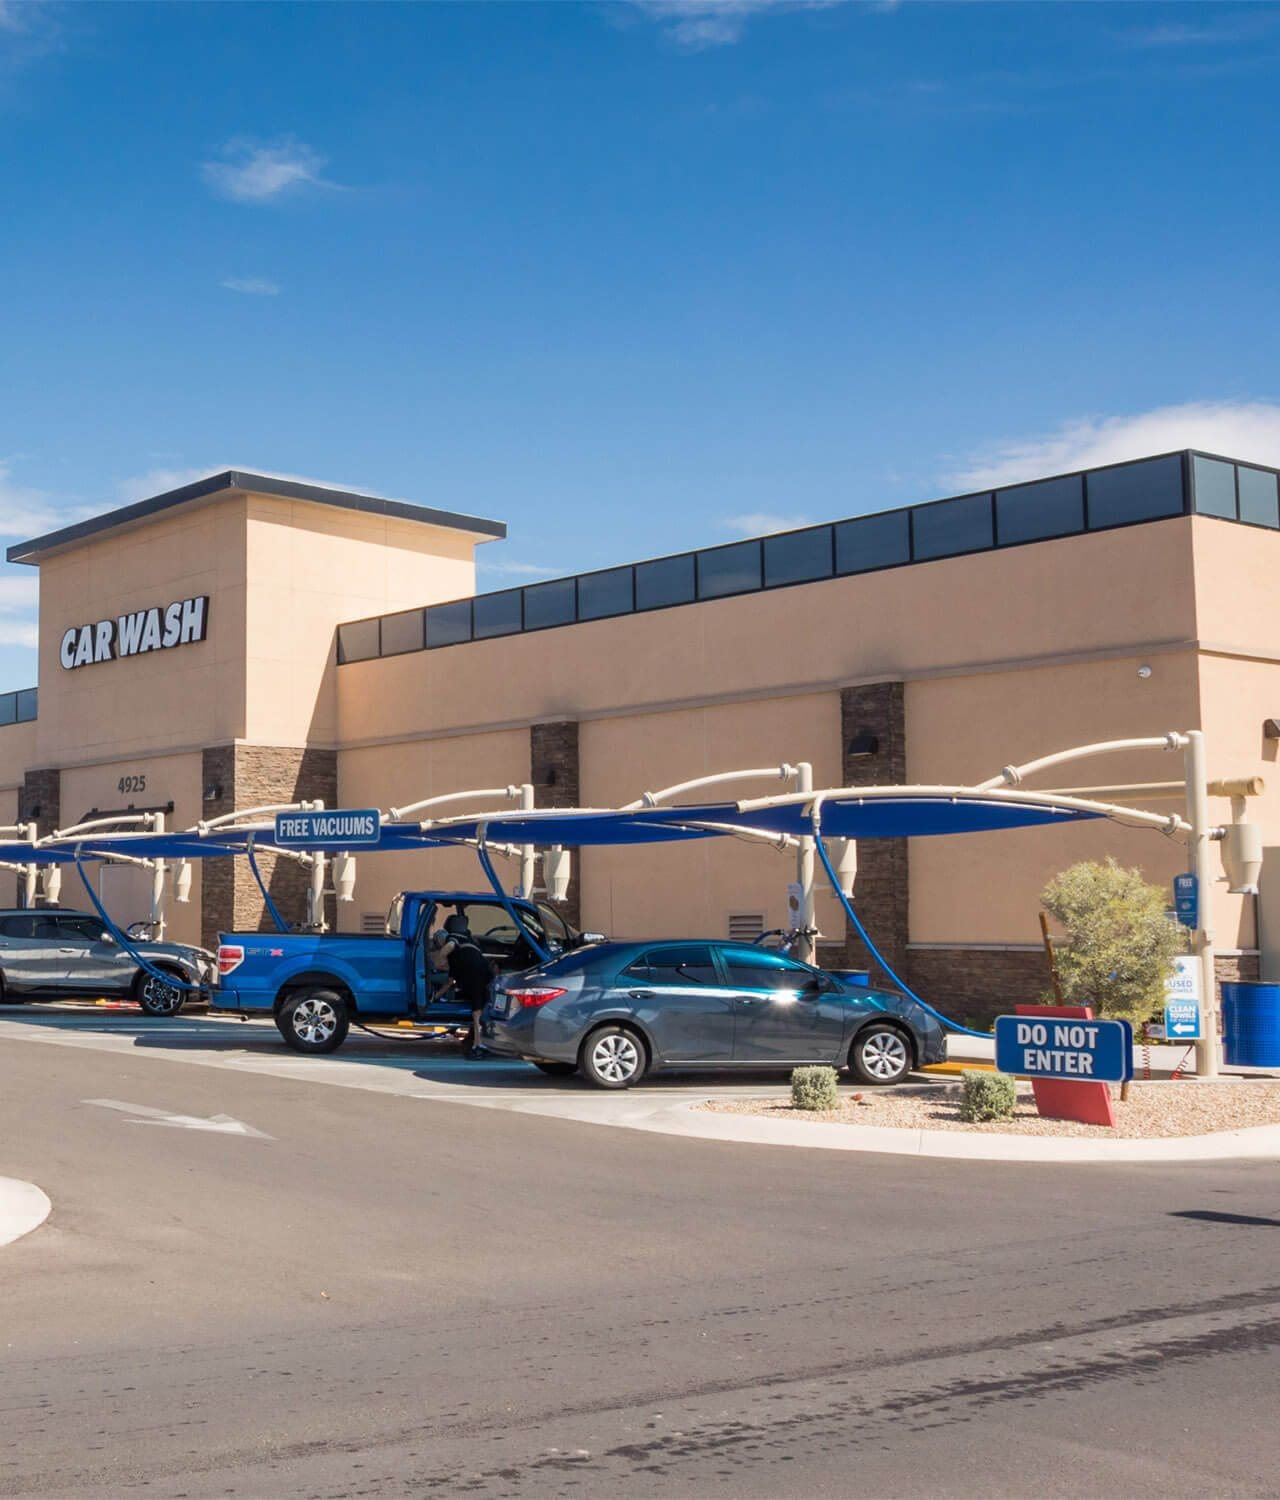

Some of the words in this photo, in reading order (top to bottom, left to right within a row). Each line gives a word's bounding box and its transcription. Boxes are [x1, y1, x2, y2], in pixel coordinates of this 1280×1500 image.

[60, 620, 116, 670] CAR
[118, 597, 208, 657] WASH
[118, 775, 146, 793] 4925
[279, 819, 310, 837] FREE
[312, 816, 375, 837] VACUUMS
[1169, 980, 1193, 988] USED
[1017, 1023, 1048, 1046] DO
[1054, 1025, 1099, 1049] NOT
[1023, 1049, 1094, 1075] ENTER
